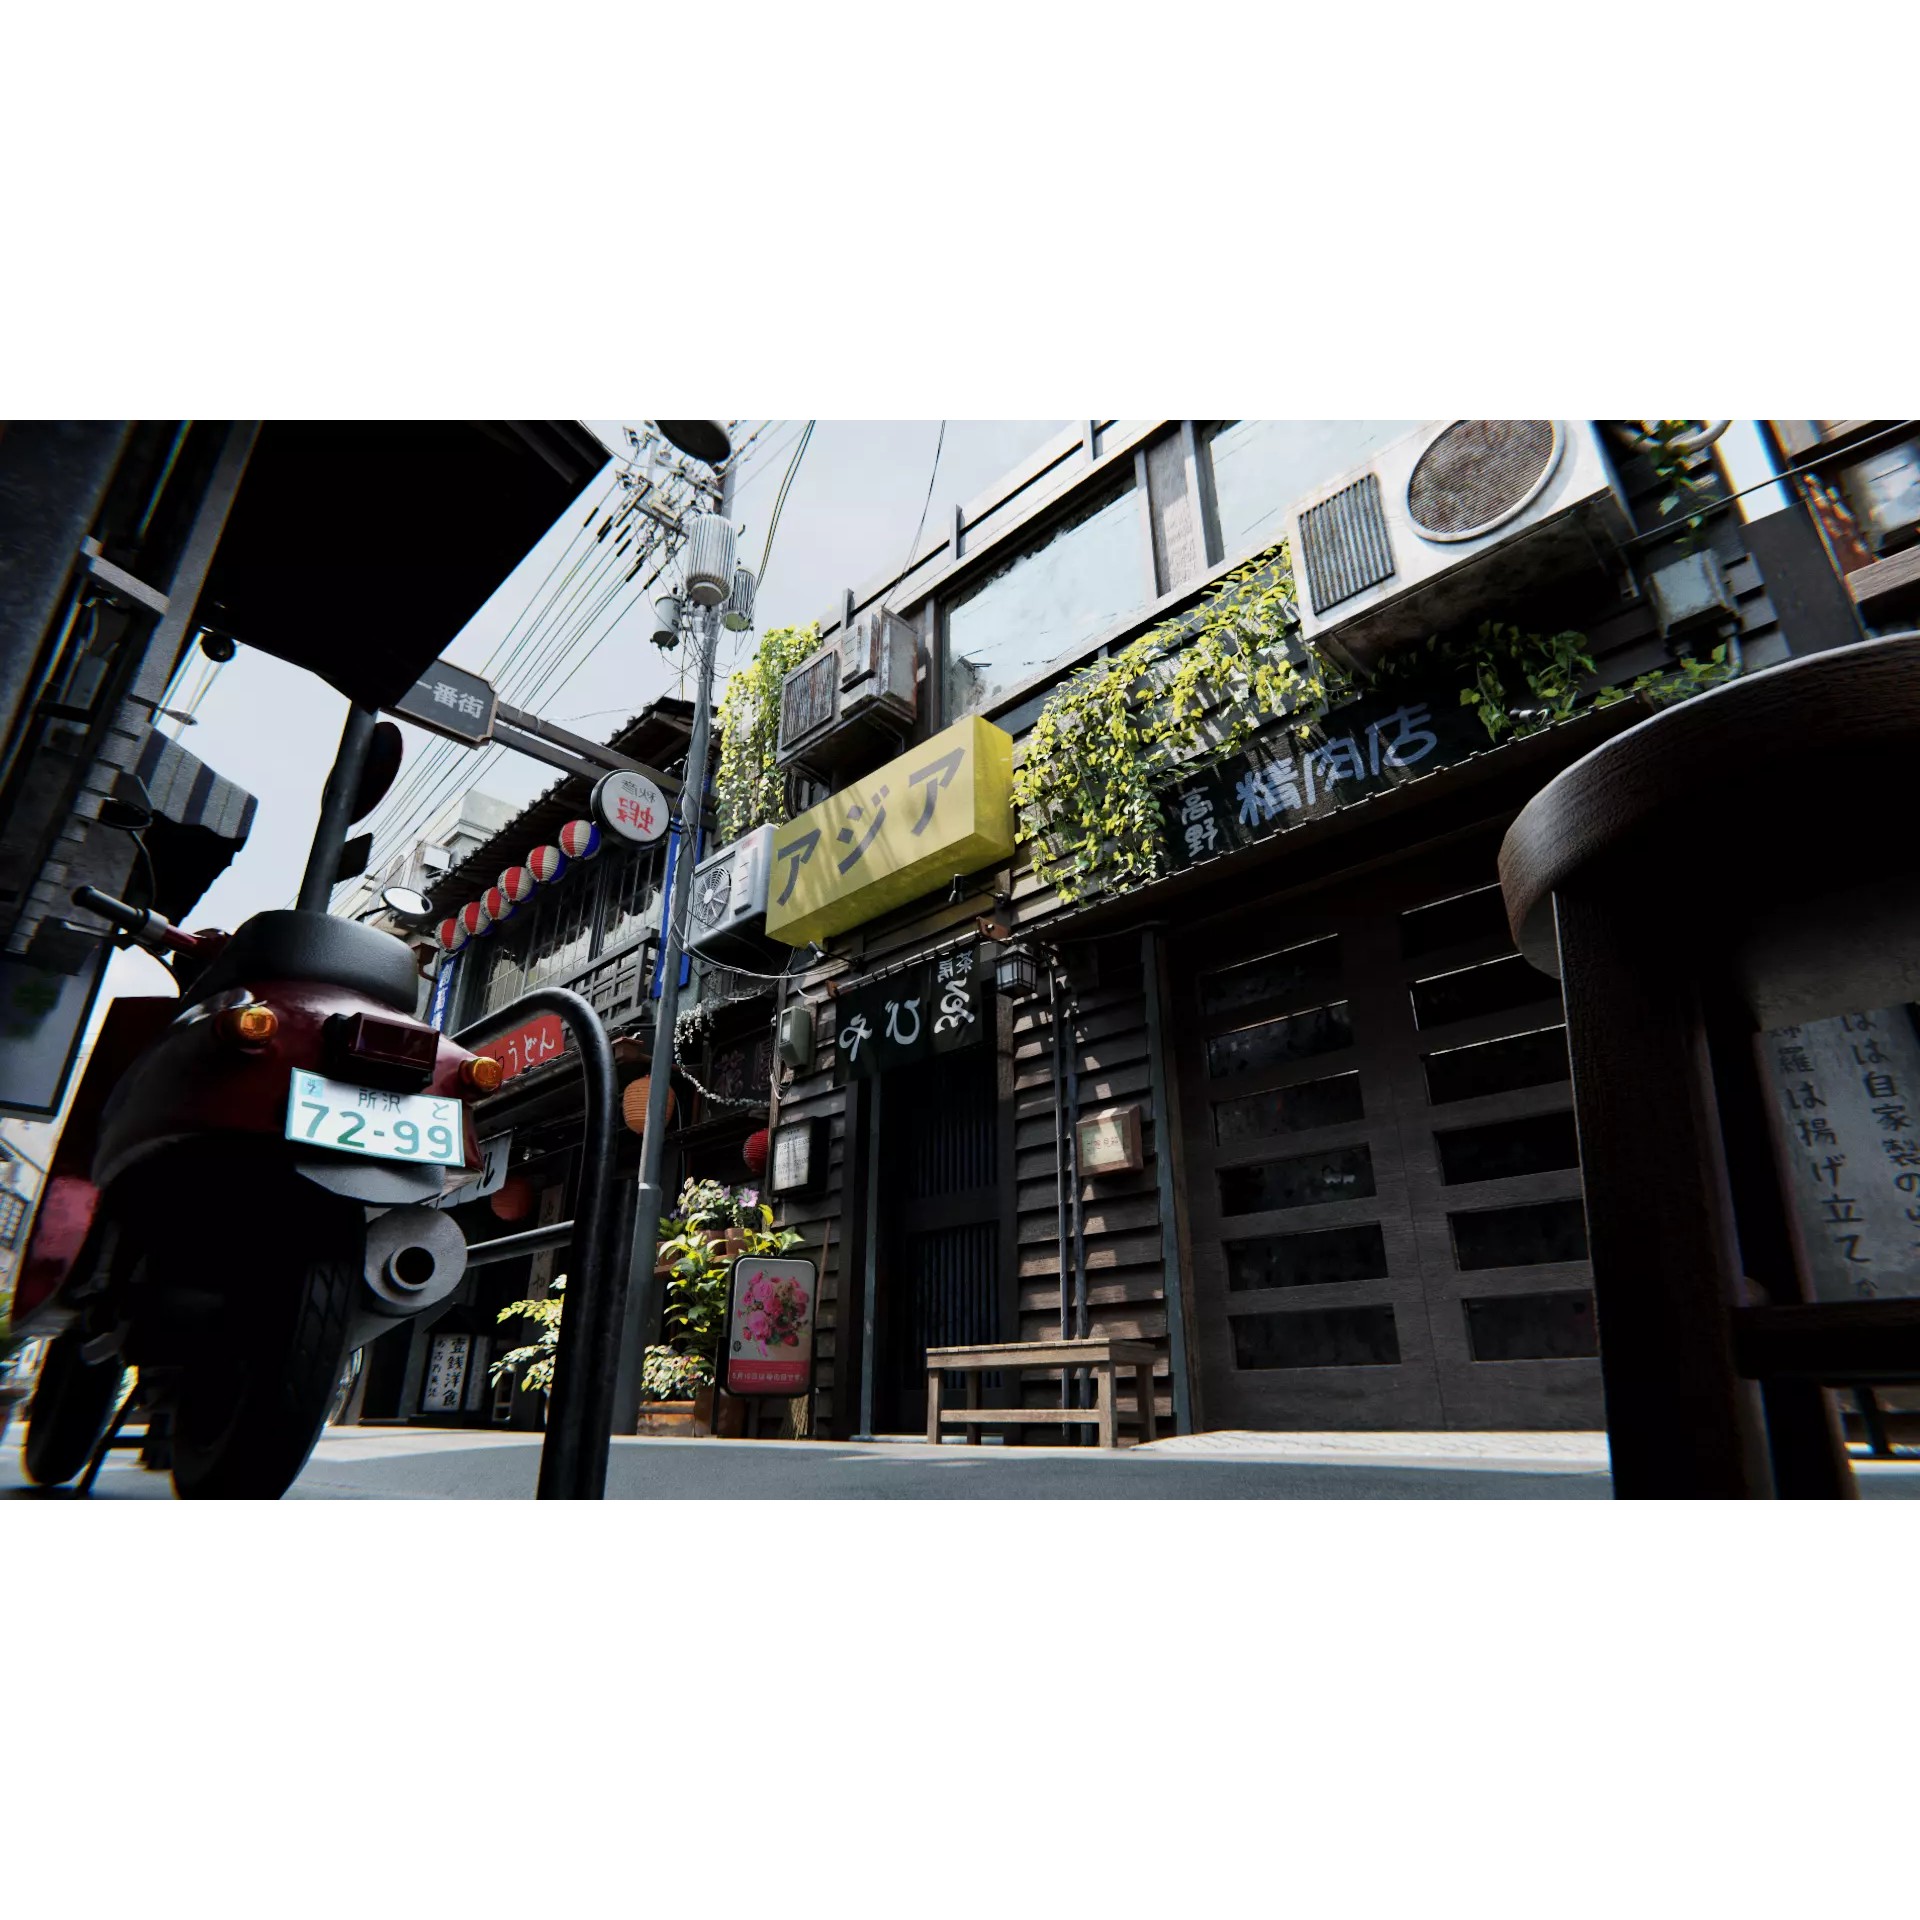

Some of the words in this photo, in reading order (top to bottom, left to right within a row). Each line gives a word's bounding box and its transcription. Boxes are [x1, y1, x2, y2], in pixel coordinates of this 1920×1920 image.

[1236, 702, 1438, 828] 精肉店
[776, 746, 965, 906] アジア
[1179, 785, 1218, 858] 高野
[508, 1027, 554, 1072] うどん
[301, 1101, 453, 1159] 72-99
[357, 1088, 402, 1114] 所沢
[432, 1102, 450, 1121] と
